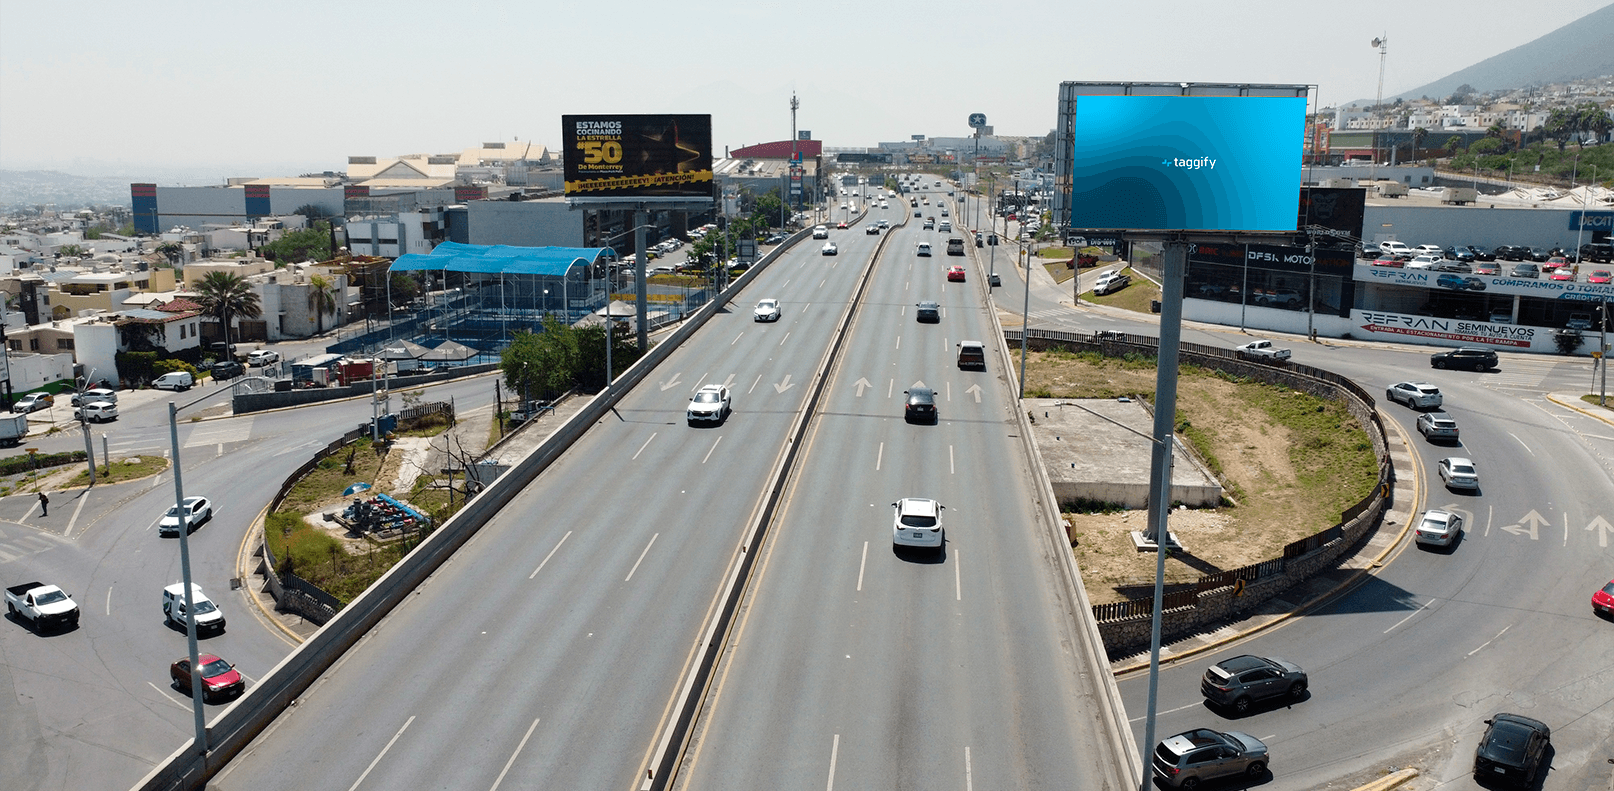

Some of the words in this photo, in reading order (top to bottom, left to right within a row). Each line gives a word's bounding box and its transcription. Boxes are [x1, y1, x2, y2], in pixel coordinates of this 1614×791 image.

[576, 121, 622, 129] ESTAMOS
[1174, 156, 1217, 170] taggify
[1370, 269, 1428, 281] REFRAN
[1492, 278, 1564, 290] COMPRAMOS
[1361, 312, 1449, 331] REFRAN
[1406, 329, 1460, 340] ESTACIONAMIENTO
[1457, 322, 1535, 337] SEMINUEVOS
